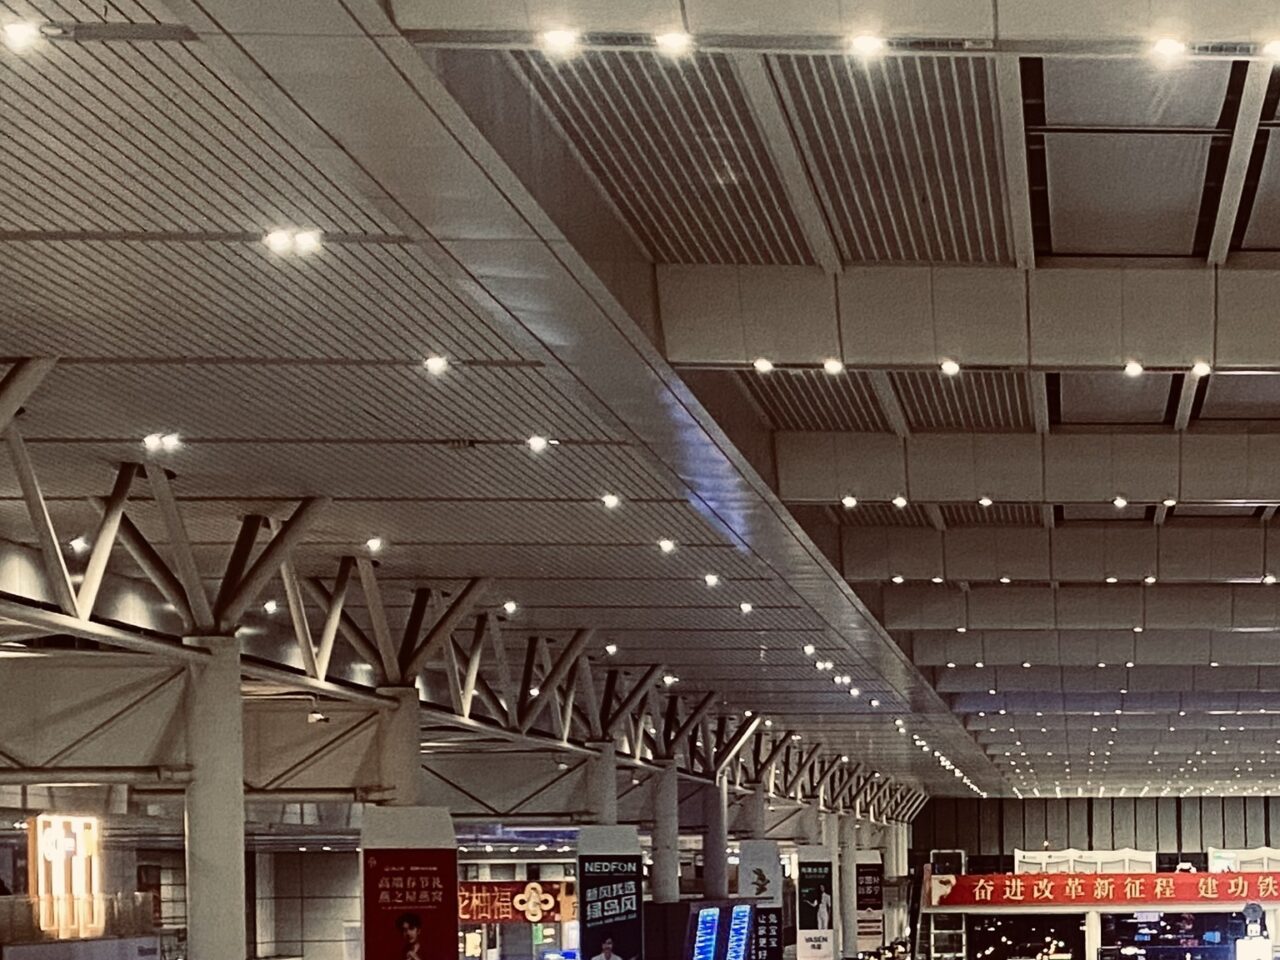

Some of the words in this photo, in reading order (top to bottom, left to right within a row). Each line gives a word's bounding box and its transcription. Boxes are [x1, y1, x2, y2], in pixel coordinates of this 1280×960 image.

[584, 862, 636, 872] NEDFON
[972, 877, 1176, 901] 奋进改革新征程
[586, 895, 637, 920] 绿岛风
